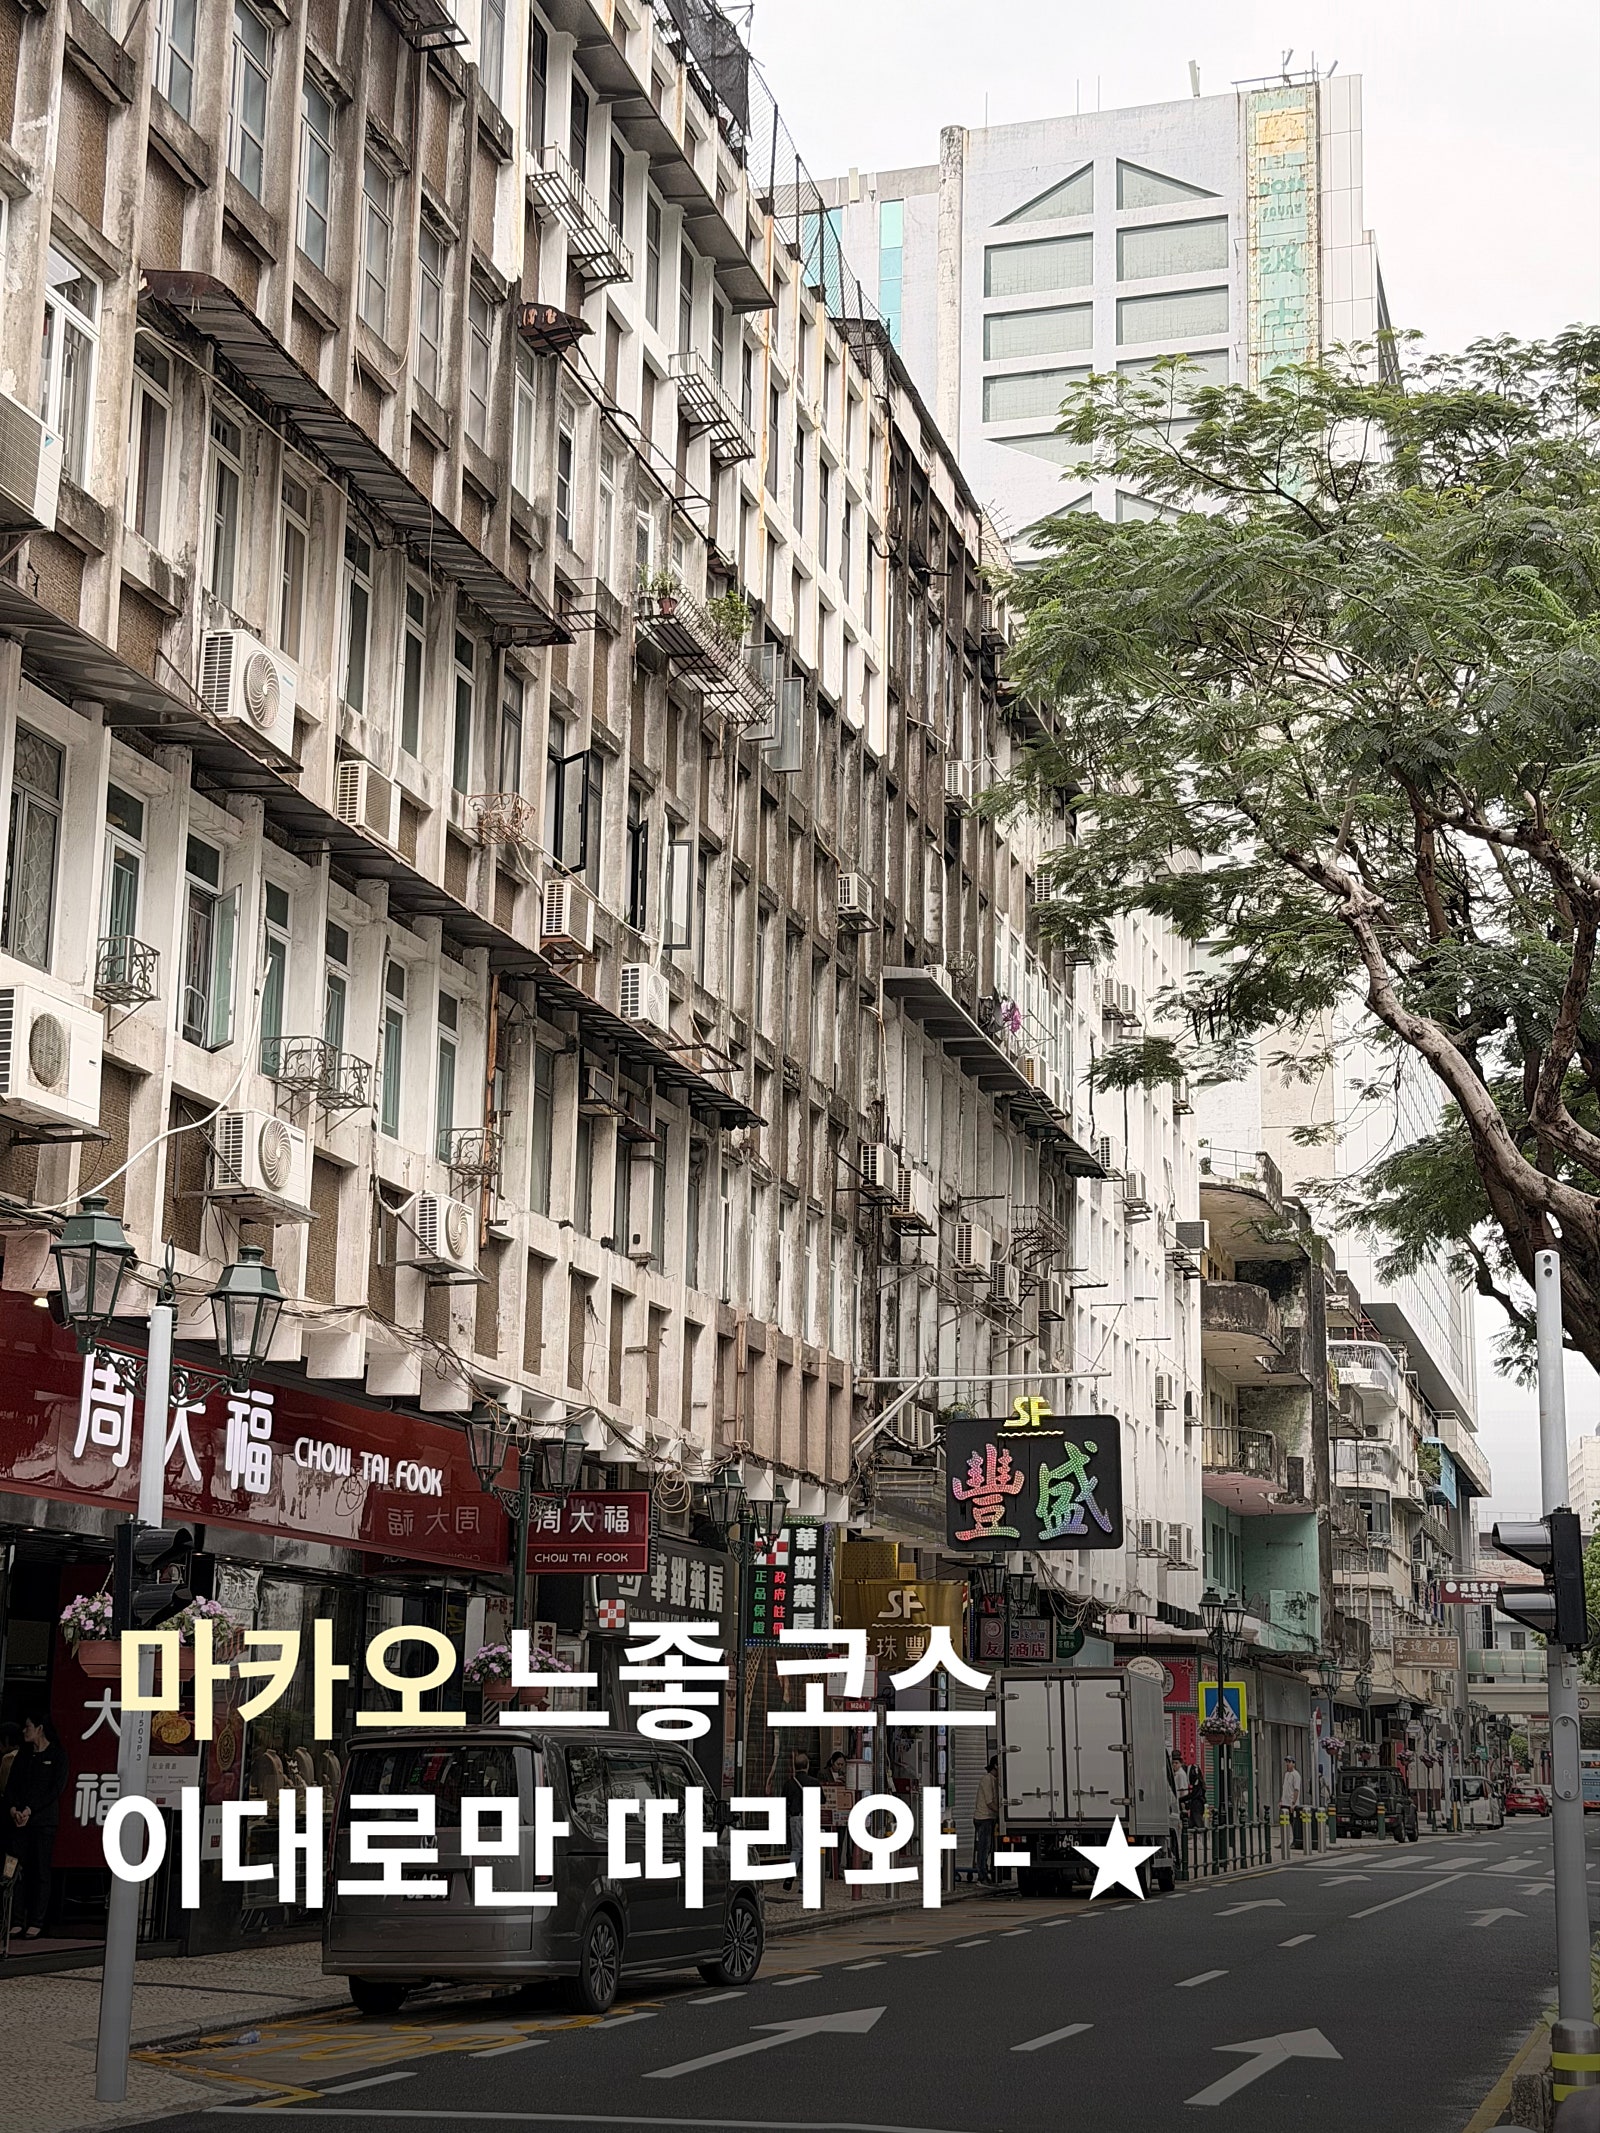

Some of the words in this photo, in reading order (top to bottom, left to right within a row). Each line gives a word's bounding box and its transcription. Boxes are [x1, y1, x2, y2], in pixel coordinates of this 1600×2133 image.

[1003, 1396, 1053, 1428] SF
[294, 1436, 353, 1478] CHOW
[359, 1451, 390, 1485] TAI
[395, 1460, 443, 1497] FOOK
[535, 1505, 630, 1534] 周大福
[534, 1552, 569, 1564] CHOW
[571, 1552, 592, 1564] TAI
[595, 1552, 629, 1564] FOOK
[752, 1570, 768, 1635] 正品保證
[877, 1590, 926, 1619] SF
